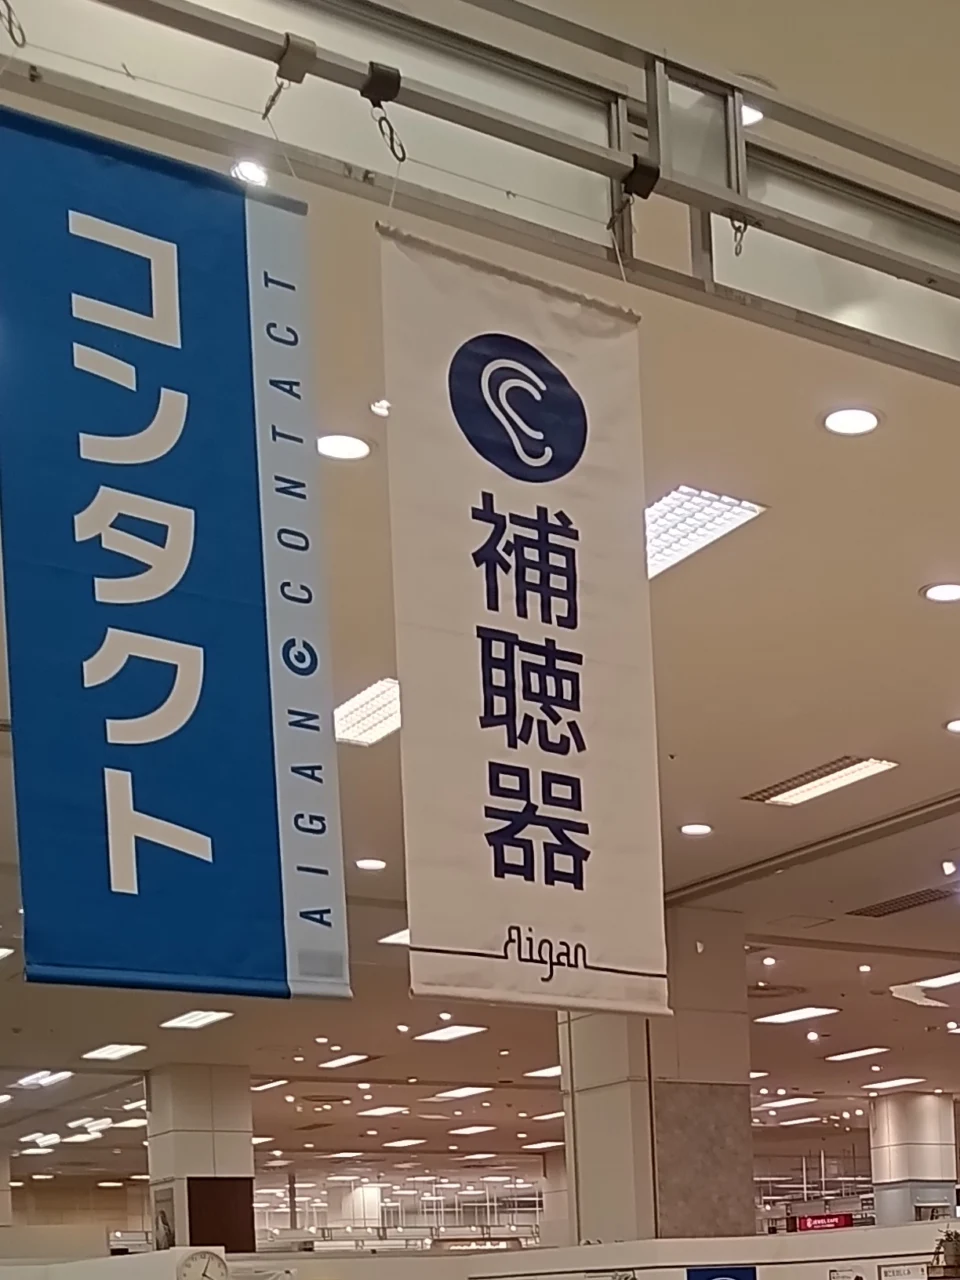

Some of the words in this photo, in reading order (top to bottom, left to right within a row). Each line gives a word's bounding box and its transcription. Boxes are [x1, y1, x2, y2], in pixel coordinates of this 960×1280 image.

[68, 209, 213, 896] コンタクト
[264, 271, 312, 605] CONTACT
[288, 709, 333, 927] AIGAN
[470, 493, 591, 892] 補聴器
[503, 926, 589, 982] Aigan
